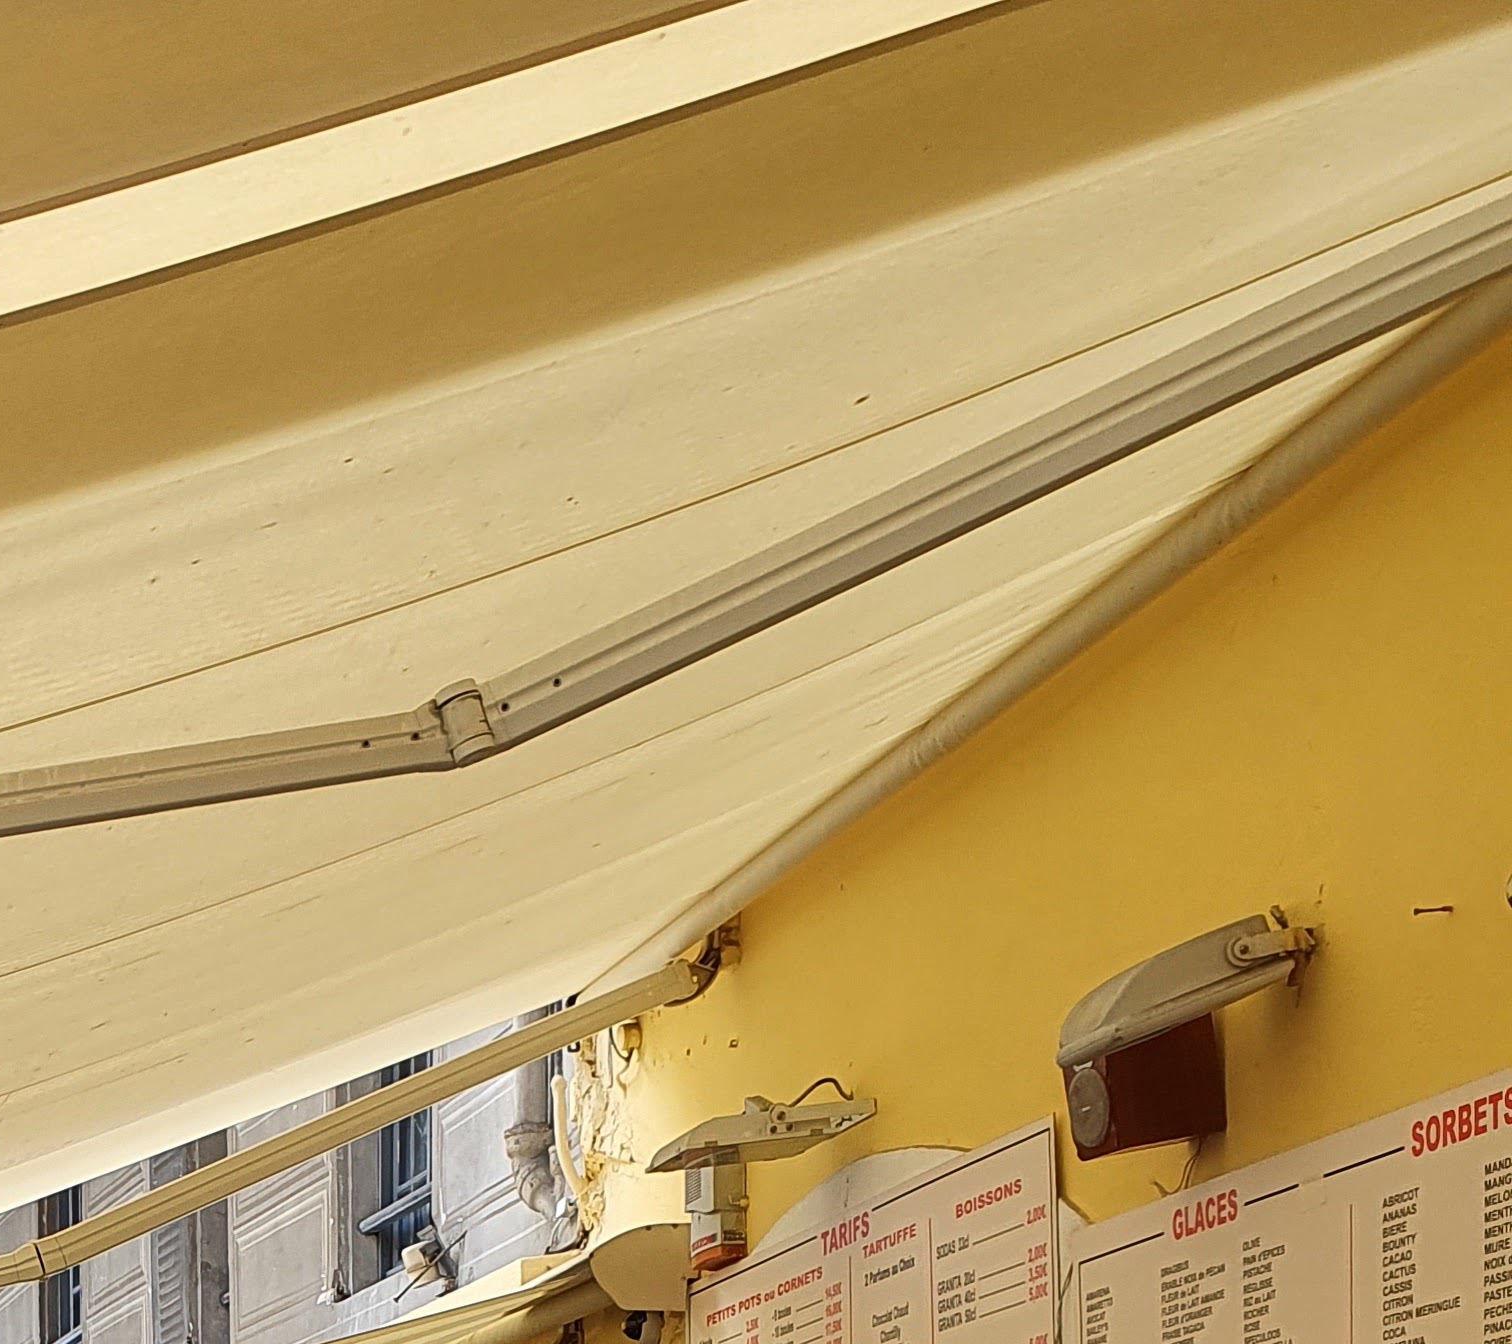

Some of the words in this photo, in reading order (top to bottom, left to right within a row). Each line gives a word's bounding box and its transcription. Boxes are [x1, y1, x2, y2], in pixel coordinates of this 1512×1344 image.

[1411, 1086, 1512, 1158] SORBETS
[1485, 1157, 1512, 1175] MAND
[955, 1179, 1022, 1219] BOISSONS
[1383, 1187, 1420, 1209] ABRICOT
[1173, 1189, 1237, 1240] GLACES
[1383, 1204, 1417, 1224] ANANAS
[821, 1211, 870, 1256] TARIFS
[1383, 1221, 1407, 1239] BIERE
[862, 1223, 916, 1259] TARTUFFE
[1383, 1233, 1418, 1253] BOUNTY
[1485, 1238, 1511, 1255] MURE
[1383, 1249, 1412, 1268] CACAO
[1484, 1254, 1506, 1271] NOIX
[1383, 1263, 1416, 1281] CACTUS
[707, 1305, 736, 1327] PETITS
[738, 1293, 761, 1313] POTS
[764, 1291, 775, 1302] ou
[777, 1266, 823, 1296] CORNETS
[1383, 1280, 1413, 1296] CASSIS
[1383, 1294, 1413, 1312] CITRON
[1383, 1310, 1413, 1327] CITRON
[1416, 1296, 1461, 1318] MERINGUE
[1383, 1326, 1407, 1341] COCA
